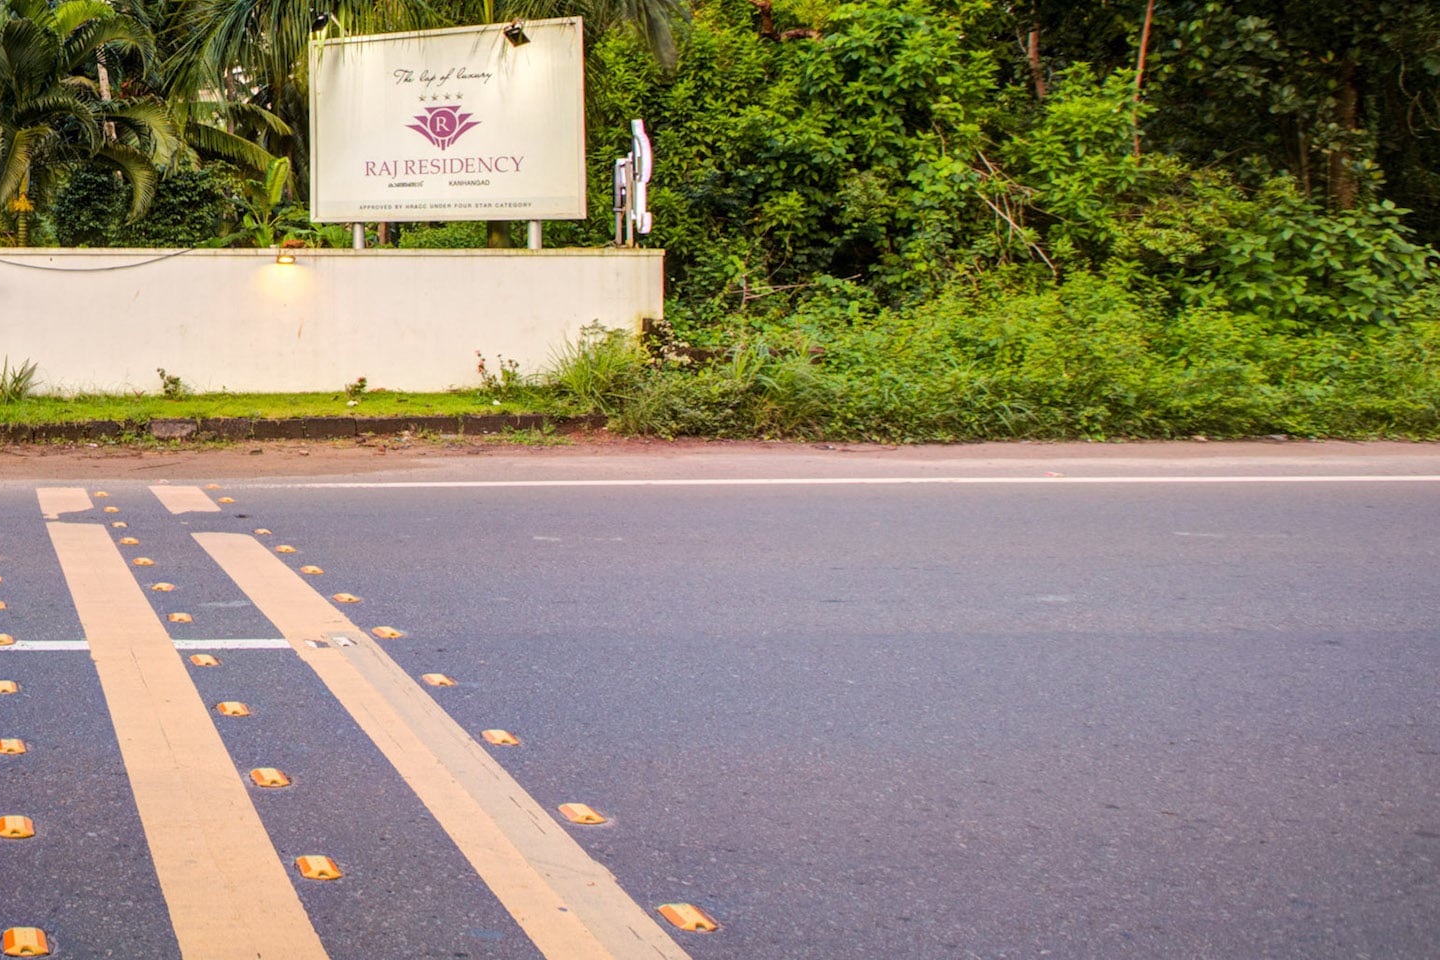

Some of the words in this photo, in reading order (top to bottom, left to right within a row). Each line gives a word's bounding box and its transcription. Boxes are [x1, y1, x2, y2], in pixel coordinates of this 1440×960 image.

[394, 68, 414, 85] The
[419, 69, 436, 87] lap
[437, 67, 455, 87] of
[457, 66, 493, 84] luxury
[436, 116, 450, 132] R
[365, 159, 398, 179] RAJ
[404, 155, 525, 176] RESIDENCY
[448, 179, 490, 187] KANHANGAD
